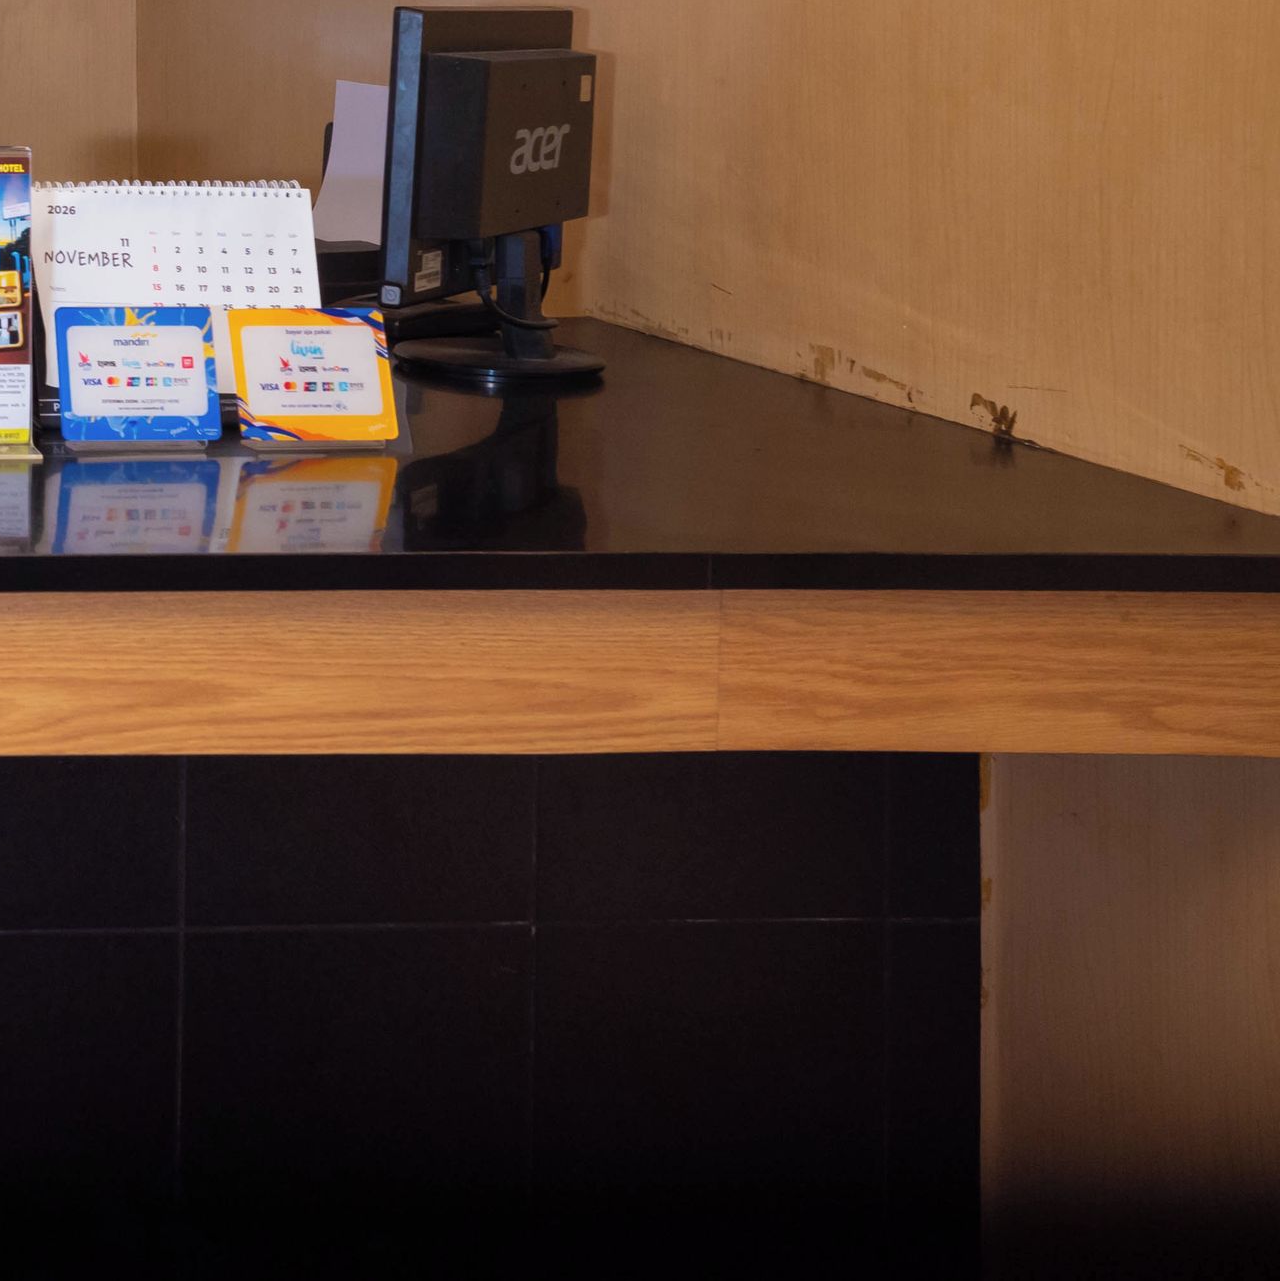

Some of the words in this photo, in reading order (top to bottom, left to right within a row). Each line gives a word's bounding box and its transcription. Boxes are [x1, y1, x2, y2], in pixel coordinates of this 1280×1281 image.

[510, 123, 571, 175] acer
[47, 205, 76, 215] 2026
[120, 238, 130, 247] 11
[268, 248, 274, 256] 6
[44, 250, 133, 268] NOVEMBER
[268, 267, 277, 275] 13
[113, 337, 149, 346] mandiri
[82, 378, 103, 386] VISA
[259, 383, 279, 391] VISA
